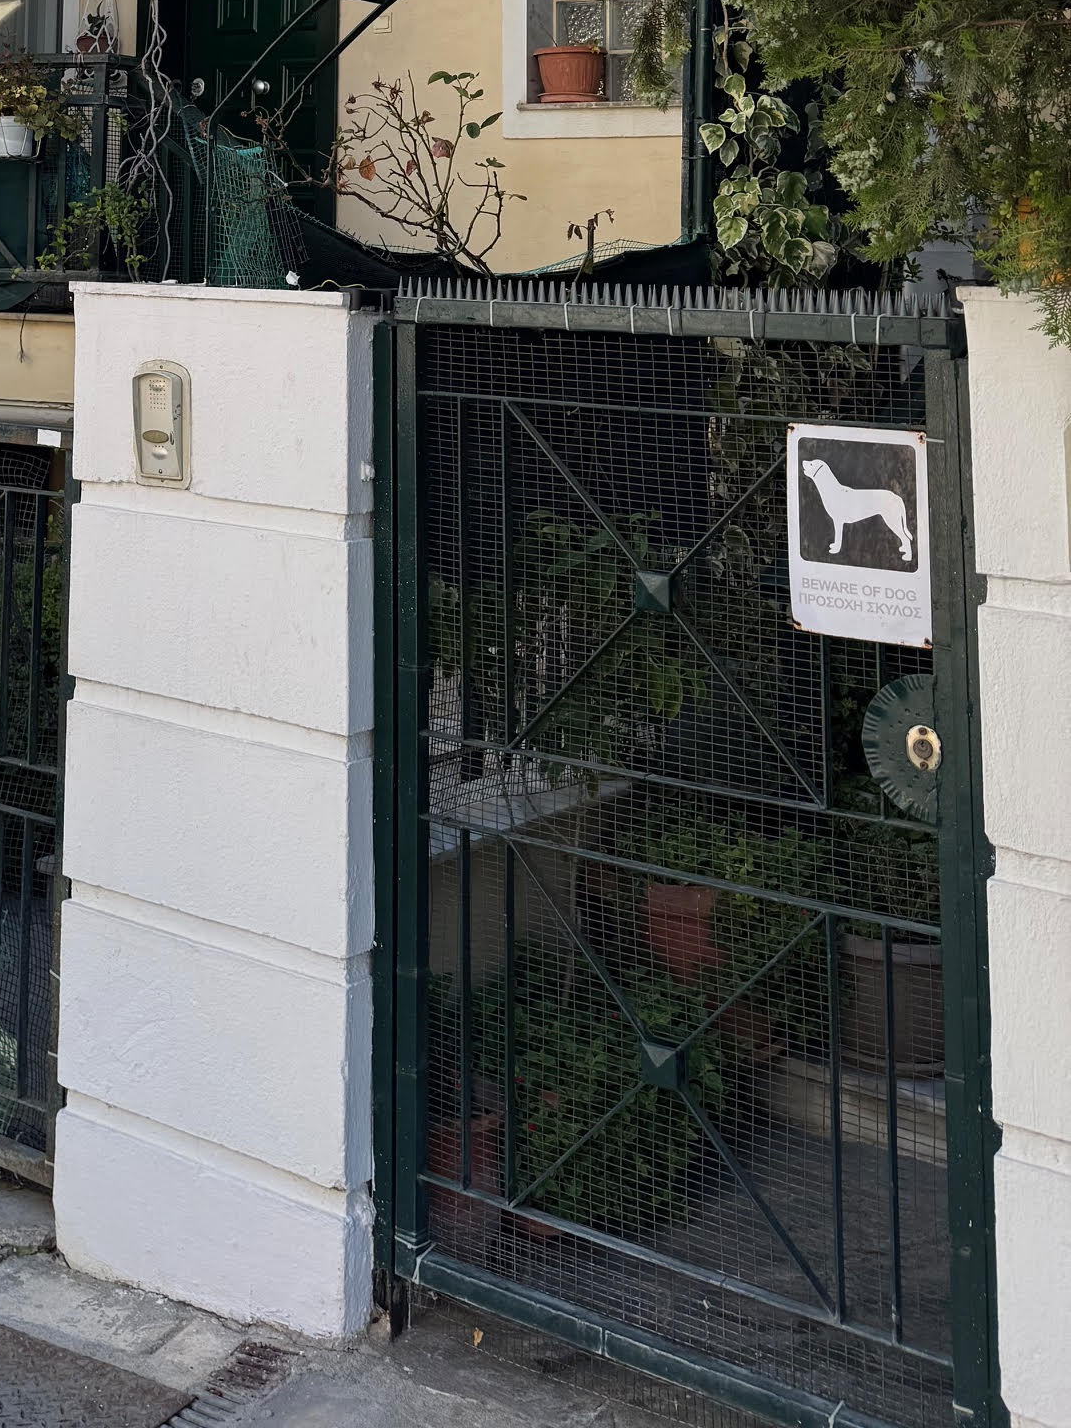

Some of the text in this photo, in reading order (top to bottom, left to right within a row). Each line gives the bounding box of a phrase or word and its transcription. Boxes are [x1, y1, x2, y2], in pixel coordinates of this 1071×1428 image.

[801, 577, 917, 602] BEWARE OF DOG
[798, 592, 922, 619] ΠΡΟΣΟΧΗ ΣΚΥΛΟΣ
